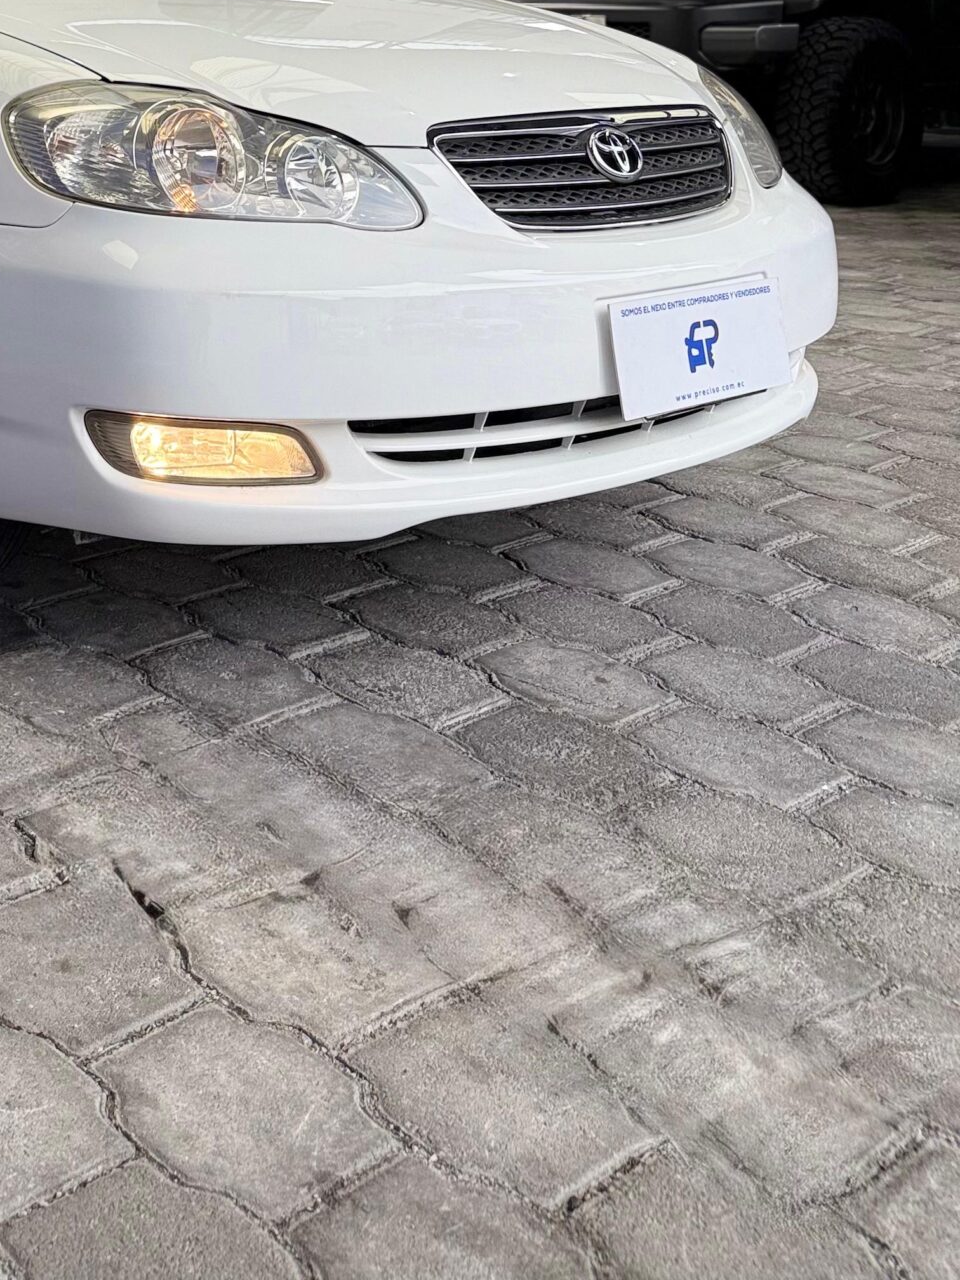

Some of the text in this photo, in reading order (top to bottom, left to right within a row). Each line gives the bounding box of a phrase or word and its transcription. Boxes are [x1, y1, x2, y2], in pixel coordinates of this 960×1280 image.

[621, 306, 642, 318] SOMOS
[643, 305, 651, 314] EL
[651, 302, 667, 312] NEXO
[668, 299, 686, 310] ENTRE
[686, 292, 730, 306] COMPRADORES
[734, 285, 771, 298] VENDEDORES
